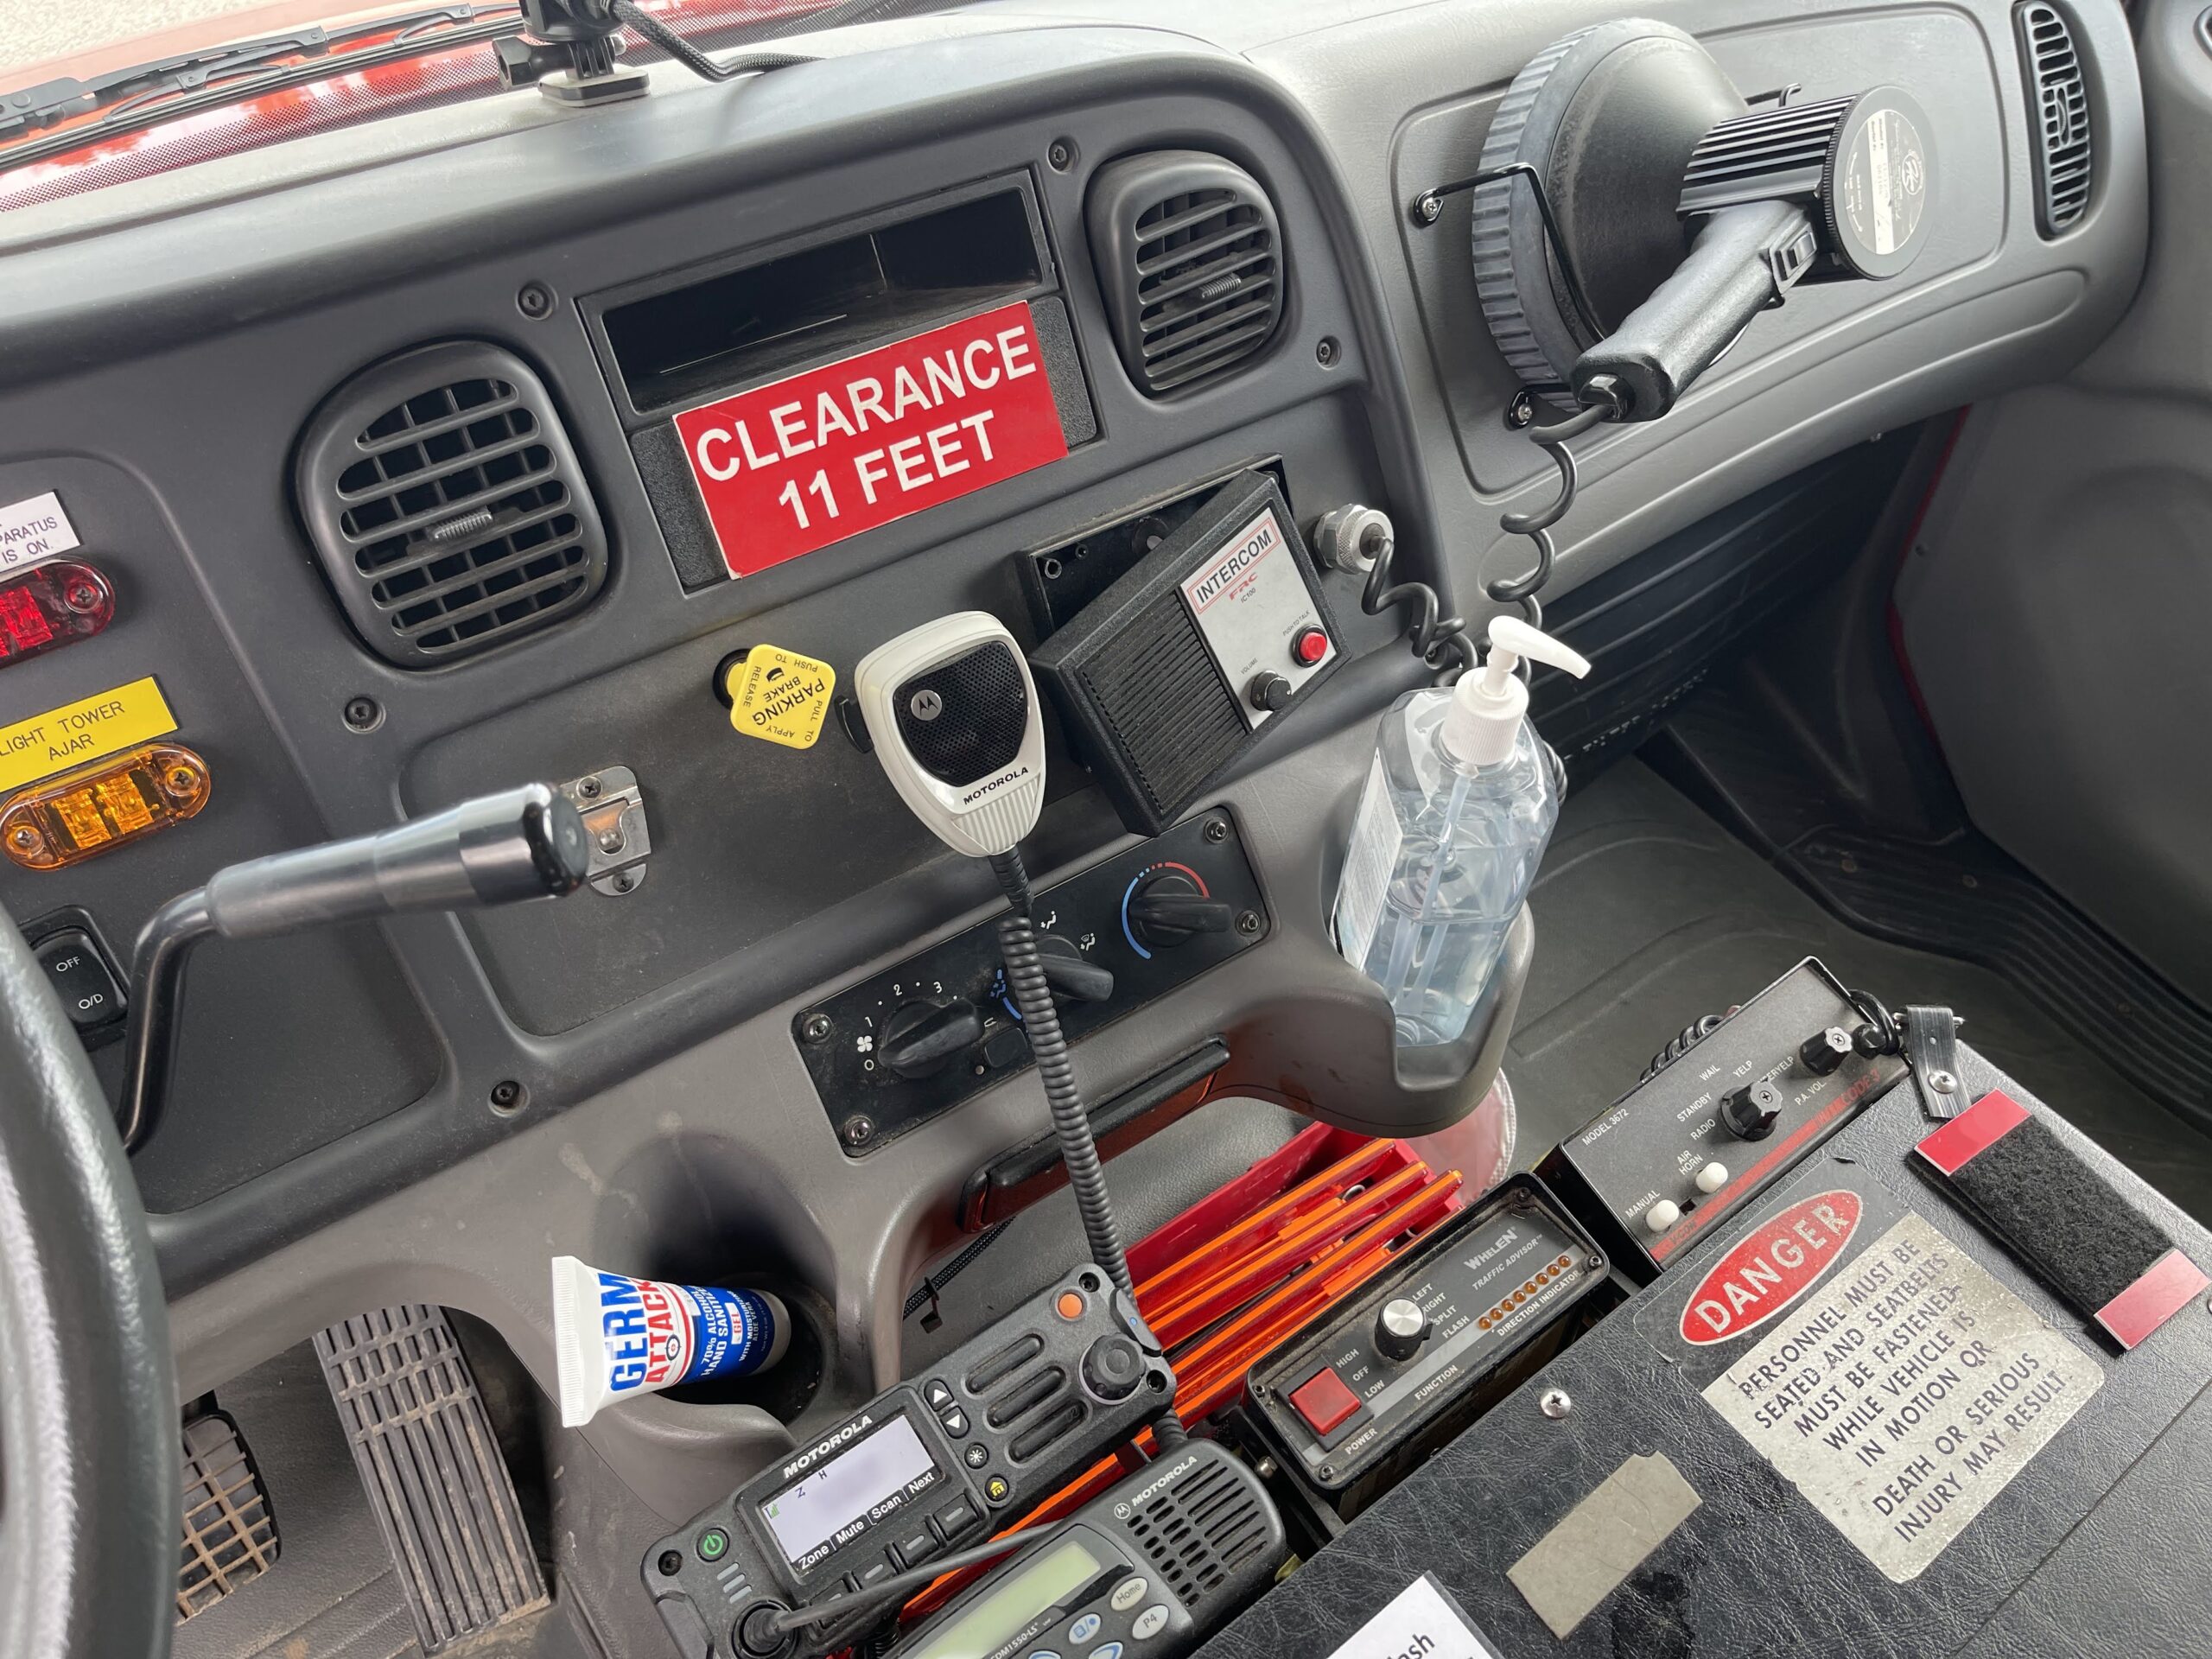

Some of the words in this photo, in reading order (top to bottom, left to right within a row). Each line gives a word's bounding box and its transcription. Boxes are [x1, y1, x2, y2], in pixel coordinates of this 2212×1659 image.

[696, 325, 1036, 481] CLEARANCE
[779, 469, 839, 529] 11
[854, 410, 995, 505] FEET
[2, 550, 18, 563] IS
[1196, 529, 1272, 603] INTERCOM
[1230, 572, 1258, 601] FRC
[1282, 625, 1294, 636] PUSH
[1299, 610, 1310, 621] TALK
[775, 653, 786, 664] TO
[794, 658, 818, 673] PUSH
[1241, 658, 1258, 674] VOLUME
[743, 665, 761, 708] RELEASE
[763, 676, 801, 702] BRAKE
[752, 678, 825, 726] PARKING
[810, 700, 823, 721] PULL
[58, 701, 125, 733] TOWER
[766, 725, 795, 738] APPLY
[804, 730, 814, 742] TO
[48, 734, 95, 761] AJAR
[963, 766, 1028, 805] MOTOROLA
[56, 957, 80, 972] OFF
[79, 994, 104, 1009] O/D
[865, 1016, 873, 1027] 1
[893, 983, 902, 995] 2
[933, 982, 943, 994] 3
[1699, 1065, 1721, 1082] WAIL
[1732, 1060, 1752, 1077] YELP
[1794, 1093, 1810, 1106] P.A.
[1808, 1080, 1827, 1094] VOL.
[1841, 1074, 1870, 1104] CODE
[1870, 1068, 1880, 1082] 3
[1676, 1092, 1712, 1122] STANDBY
[1582, 1122, 1612, 1146] MODEL
[1610, 1108, 1630, 1128] 3672
[1690, 1119, 1716, 1142] RADIO
[1676, 1149, 1691, 1164] AIR
[1678, 1154, 1704, 1176] HORN
[1625, 1189, 1661, 1219] MANUAL
[1464, 1229, 1518, 1270] WHELEN
[1471, 1263, 1505, 1291] TRAFFIC
[1694, 1204, 1849, 1335] DANGER
[1412, 1283, 1433, 1301] LEFT
[1421, 1293, 1446, 1313] RIGHT
[1497, 1300, 1540, 1337] DIRECTION
[1539, 1270, 1581, 1304] INDICATOR
[691, 1291, 717, 1334] ALCOHOL
[731, 1313, 741, 1333] GEL
[746, 1301, 757, 1319] VERA
[1433, 1305, 1457, 1325] SPLIT
[1738, 1306, 1847, 1401] PERSONNEL
[1844, 1260, 1896, 1309] MUST
[1893, 1239, 1921, 1265] BE
[597, 1272, 649, 1391] GERM
[629, 1277, 674, 1382] ATTACK
[1442, 1315, 1470, 1338] FLASH
[701, 1337, 717, 1364] 70%
[739, 1342, 752, 1362] WITH
[1754, 1368, 1820, 1430] SEATED
[1825, 1327, 1866, 1373] AND
[1871, 1253, 1949, 1328] SEATBELTS
[701, 1341, 727, 1376] HAND
[1335, 1349, 1359, 1369] HIGH
[1794, 1387, 1848, 1438] MUST
[1846, 1362, 1874, 1389] BE
[1873, 1286, 1960, 1364] FASTENED
[1352, 1365, 1370, 1382] OFF
[1414, 1364, 1459, 1402] FUNCTION
[1822, 1395, 1884, 1452] WHILE
[1880, 1332, 1955, 1407] VEHICLE
[1952, 1311, 1975, 1332] IS
[1364, 1379, 1385, 1398] LOW
[1855, 1440, 1884, 1468] IN
[1885, 1366, 1961, 1442] MOTION
[1961, 1339, 1993, 1369] OR
[783, 1415, 873, 1478] MOTOROLA
[1344, 1427, 1378, 1455] POWER
[1872, 1454, 1936, 1518] DEATH
[1936, 1424, 1967, 1455] OR
[1966, 1351, 2040, 1425] SERIOUS
[1893, 1476, 1963, 1543] INJURY
[1962, 1429, 2006, 1476] MAY
[2003, 1370, 2067, 1432] RESULT
[818, 1469, 828, 1480] H
[1132, 1455, 1198, 1508] MOTOROLA
[794, 1485, 805, 1498] Z
[798, 1542, 830, 1570] Zone
[836, 1519, 865, 1545] Mute
[870, 1494, 902, 1521] Scan
[907, 1471, 935, 1495] Next
[1116, 1583, 1141, 1604] Home
[1143, 1613, 1158, 1629] P4
